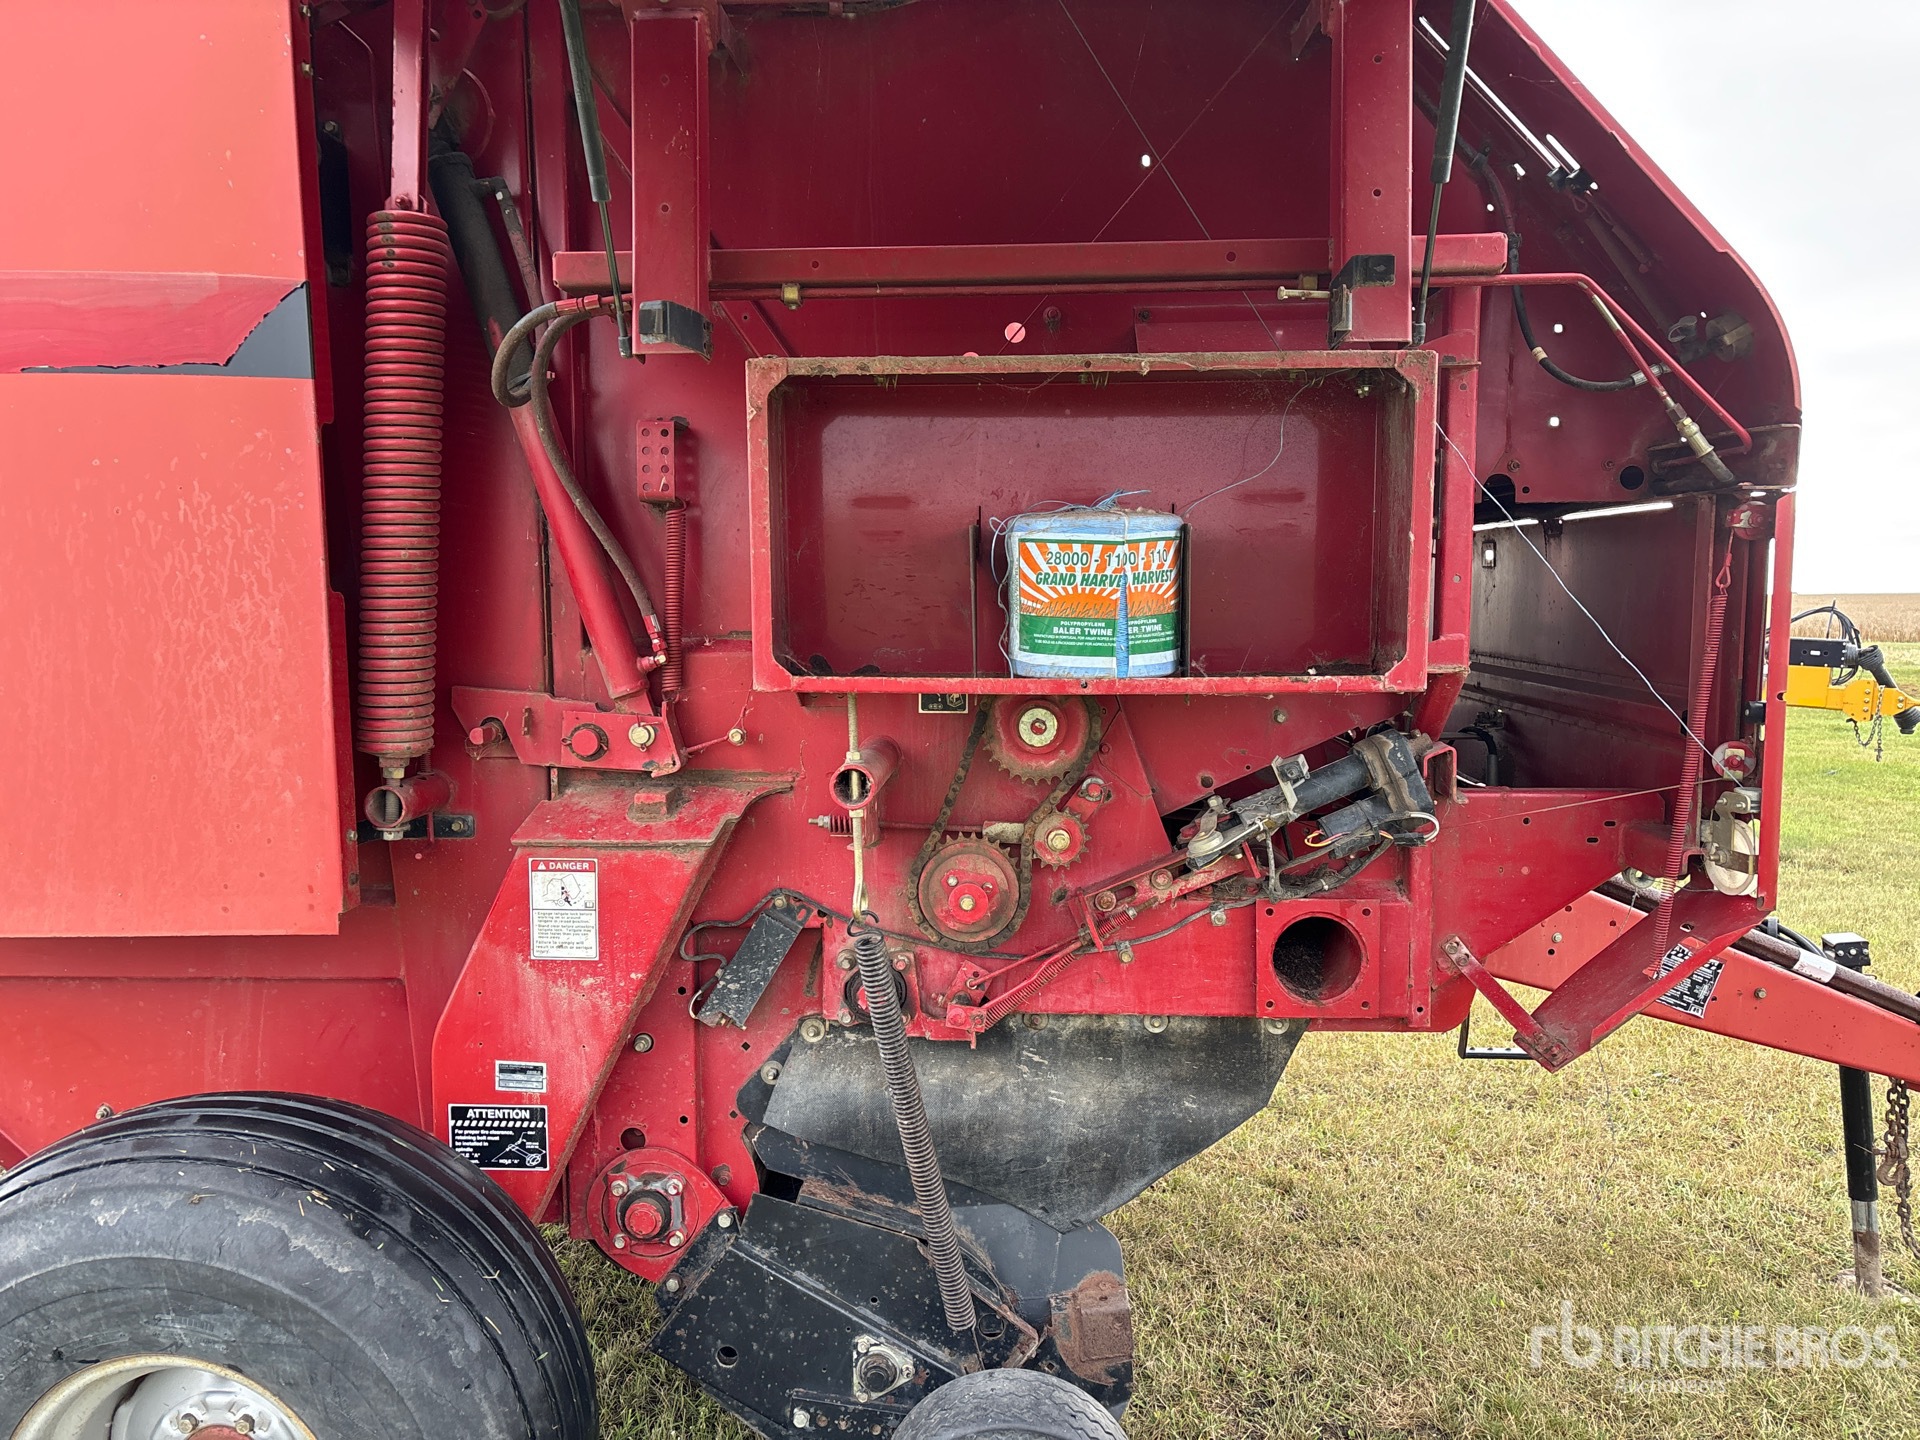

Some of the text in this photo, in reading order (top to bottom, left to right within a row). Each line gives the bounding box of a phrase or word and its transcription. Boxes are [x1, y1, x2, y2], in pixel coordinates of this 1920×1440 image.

[1046, 551, 1089, 566] 28000
[1106, 551, 1136, 567] 1100
[1151, 549, 1168, 564] 110
[1036, 569, 1173, 588] GRAND HARVE HARVEST
[1053, 626, 1113, 636] BALER TWINE
[1141, 623, 1162, 632] TWINE
[549, 862, 589, 870] DANGER
[467, 1108, 530, 1119] ATTENTION
